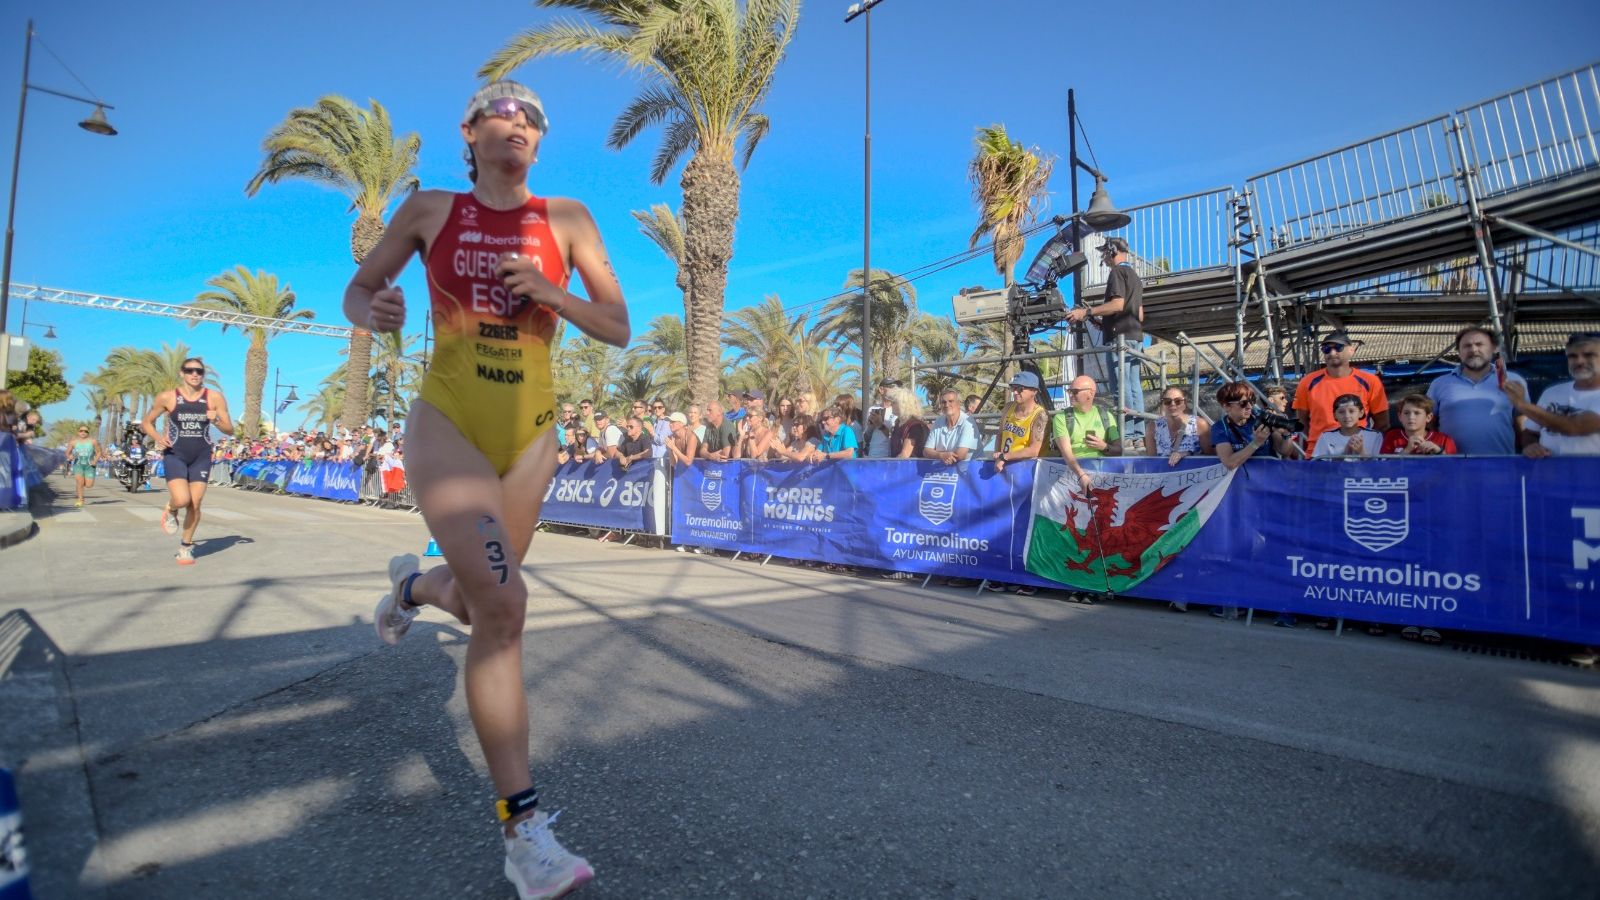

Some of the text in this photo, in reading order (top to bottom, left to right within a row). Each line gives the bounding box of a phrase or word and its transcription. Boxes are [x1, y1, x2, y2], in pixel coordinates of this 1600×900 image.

[484, 234, 541, 247] Iberdrola
[454, 249, 543, 279] GUERO
[476, 363, 524, 384] NARON
[181, 421, 202, 430] USA
[1178, 472, 1202, 487] TRI
[1206, 466, 1231, 481] CLU
[766, 486, 823, 505] TORRE
[685, 513, 743, 530] Torremolinos
[763, 502, 835, 522] MOLINOS
[690, 529, 737, 542] AYUNTAMIENTO
[884, 526, 990, 552] Torremolinos
[892, 548, 978, 566] AYUNTAMIENTO
[1286, 555, 1481, 592] Torremolinos
[1303, 585, 1457, 612] AYUNTAMIENTO
